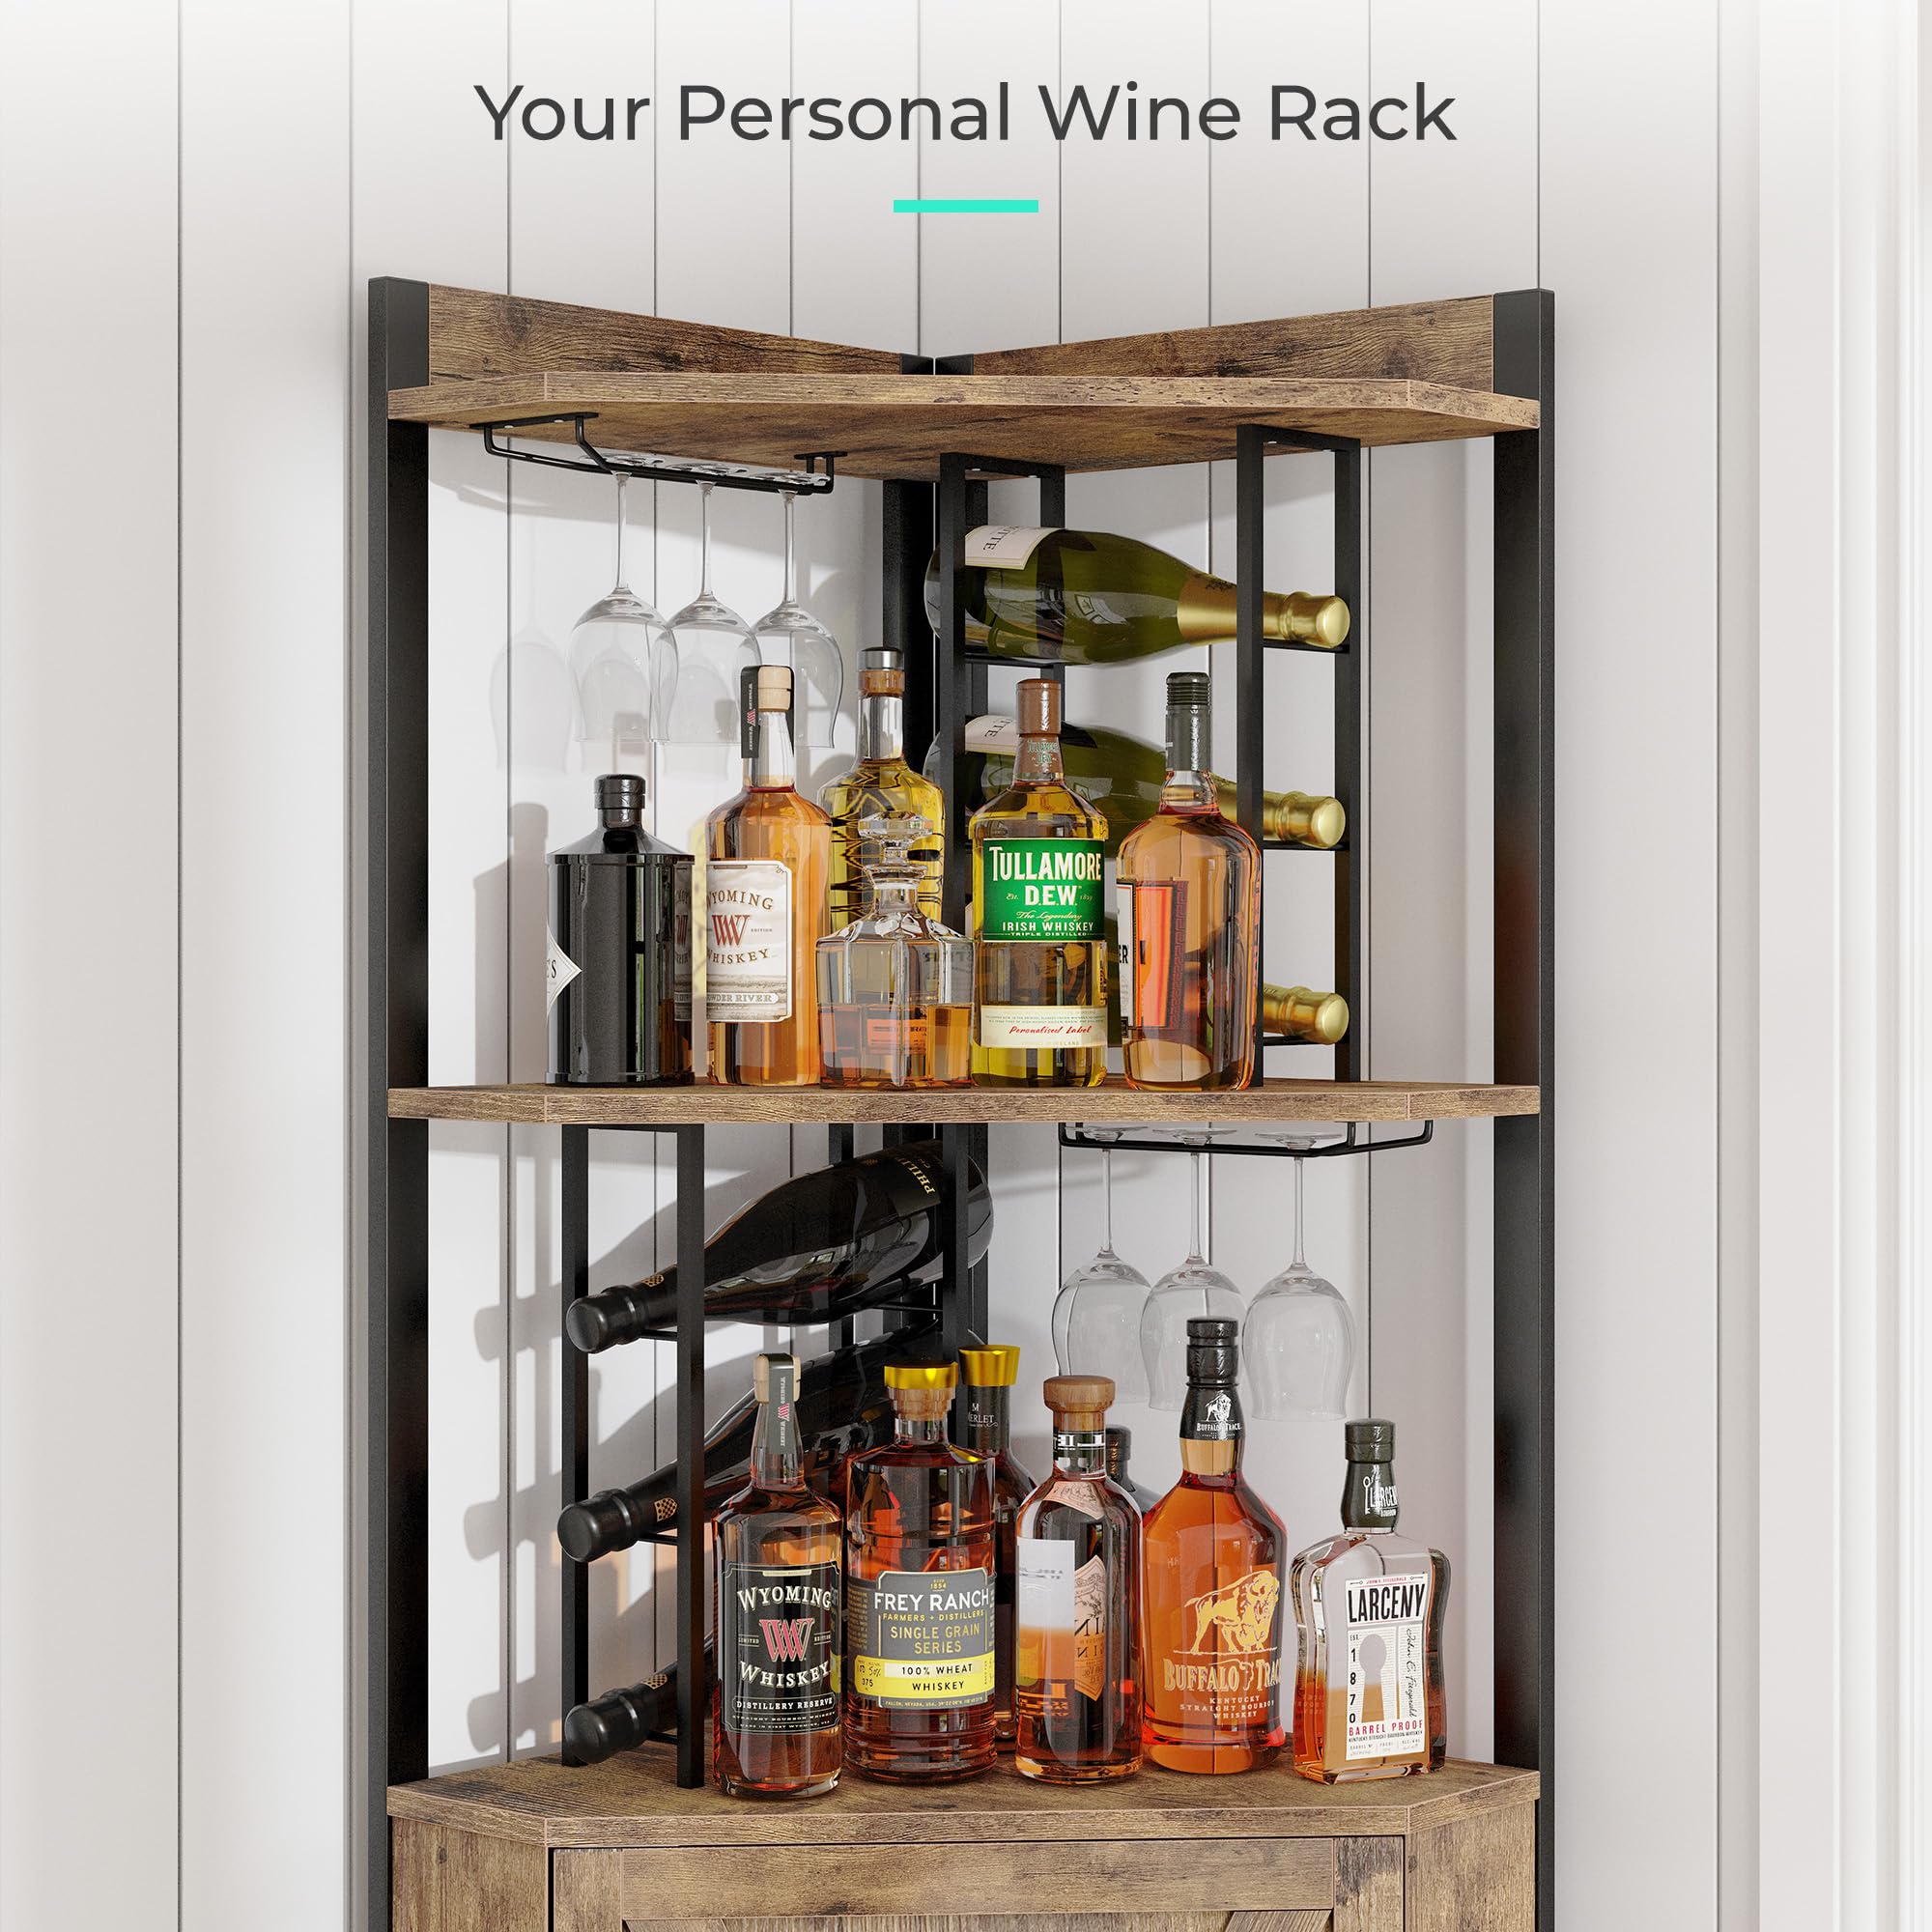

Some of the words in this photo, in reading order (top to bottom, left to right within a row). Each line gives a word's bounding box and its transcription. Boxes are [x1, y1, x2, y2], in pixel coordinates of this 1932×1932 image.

[988, 846, 1101, 881] TULLAMORE
[1016, 910, 1036, 919] The
[1037, 911, 1082, 922] Legendary
[1003, 922, 1037, 931] IRISH
[1042, 922, 1094, 931] WHISKEY
[707, 993, 732, 1003] OWDER
[735, 993, 773, 1003] RIVER
[1066, 1025, 1093, 1034] Label
[737, 1585, 832, 1613] WYOMING
[874, 1592, 923, 1611] FREY
[929, 1588, 989, 1611] RANCH
[1348, 1583, 1425, 1623] LARCENY
[883, 1612, 925, 1621] FARMERS
[939, 1609, 984, 1621] DISTILLERS
[891, 1626, 939, 1639] SINGLE
[945, 1623, 980, 1638] GRAIN
[915, 1640, 962, 1655] SERIES
[740, 1661, 831, 1689] WHISKEY
[901, 1666, 929, 1675] 100%
[935, 1663, 973, 1675] WHEAT
[1163, 1658, 1240, 1691] BUFFALO
[912, 1681, 964, 1691] WHISKEY
[736, 1700, 794, 1710] DISTILLERY
[797, 1697, 833, 1709] RESERVE
[1209, 1695, 1260, 1704] KENTUCKY
[1349, 1723, 1386, 1737] BARREL
[1392, 1719, 1423, 1731] PROOF
